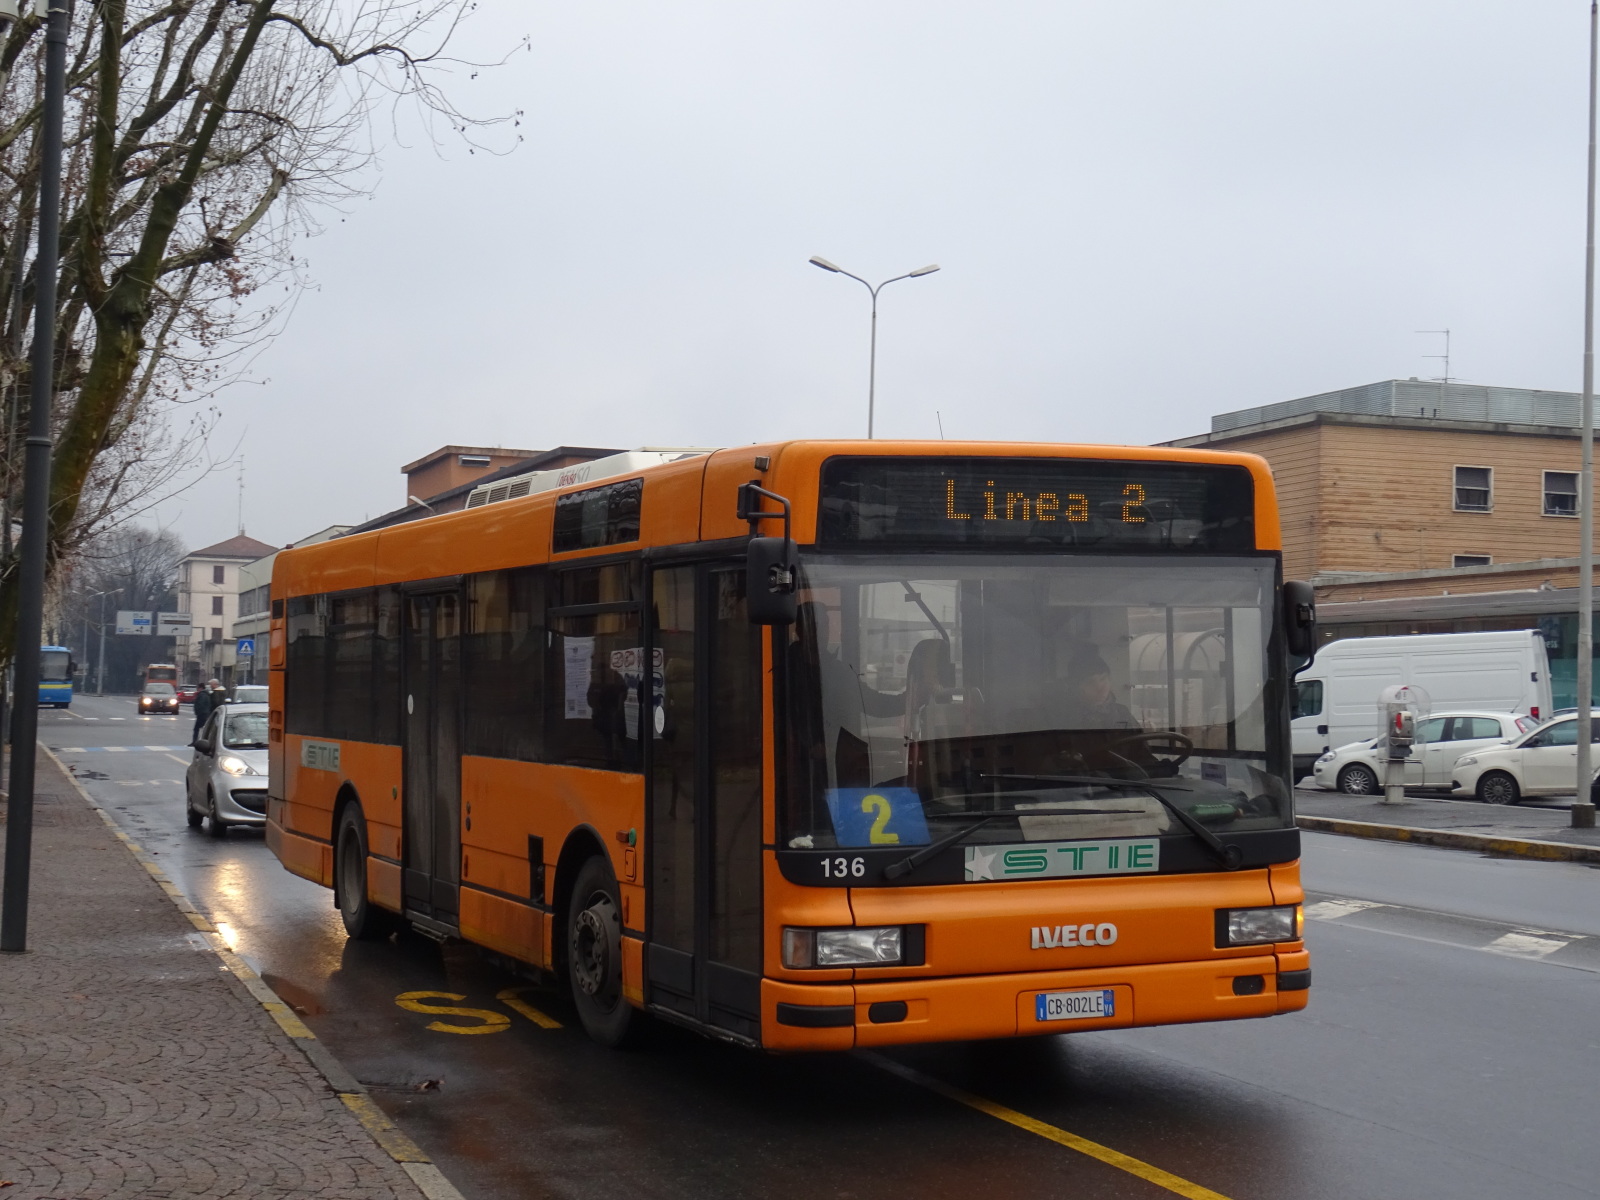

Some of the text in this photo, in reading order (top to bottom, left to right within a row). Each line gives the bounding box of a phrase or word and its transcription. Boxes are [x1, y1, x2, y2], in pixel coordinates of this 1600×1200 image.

[947, 479, 1145, 522] Linea 2
[861, 795, 900, 845] 2
[820, 857, 866, 878] 136
[1030, 922, 1119, 949] IVECO
